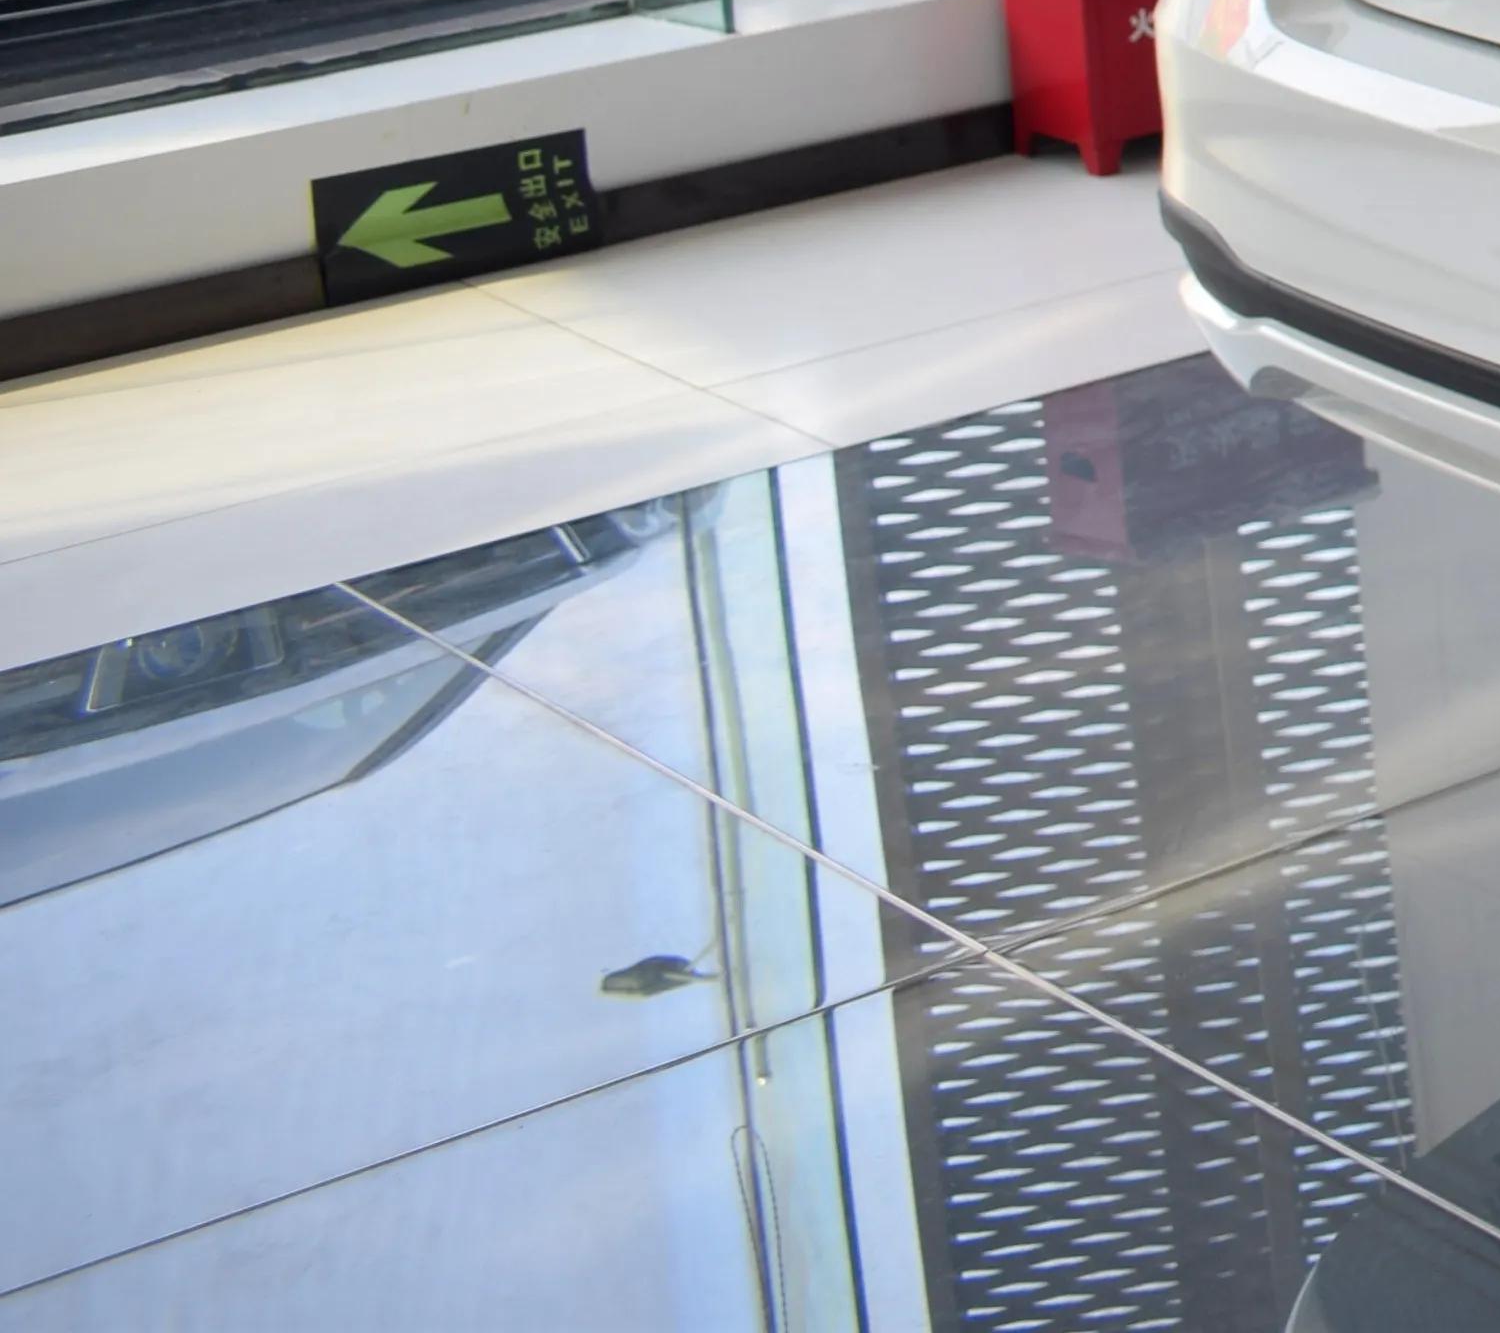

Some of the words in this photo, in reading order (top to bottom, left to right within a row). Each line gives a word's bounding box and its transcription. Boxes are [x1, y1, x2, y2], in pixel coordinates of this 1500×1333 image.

[517, 147, 562, 252] 安全出口
[552, 153, 590, 235] EXIT
